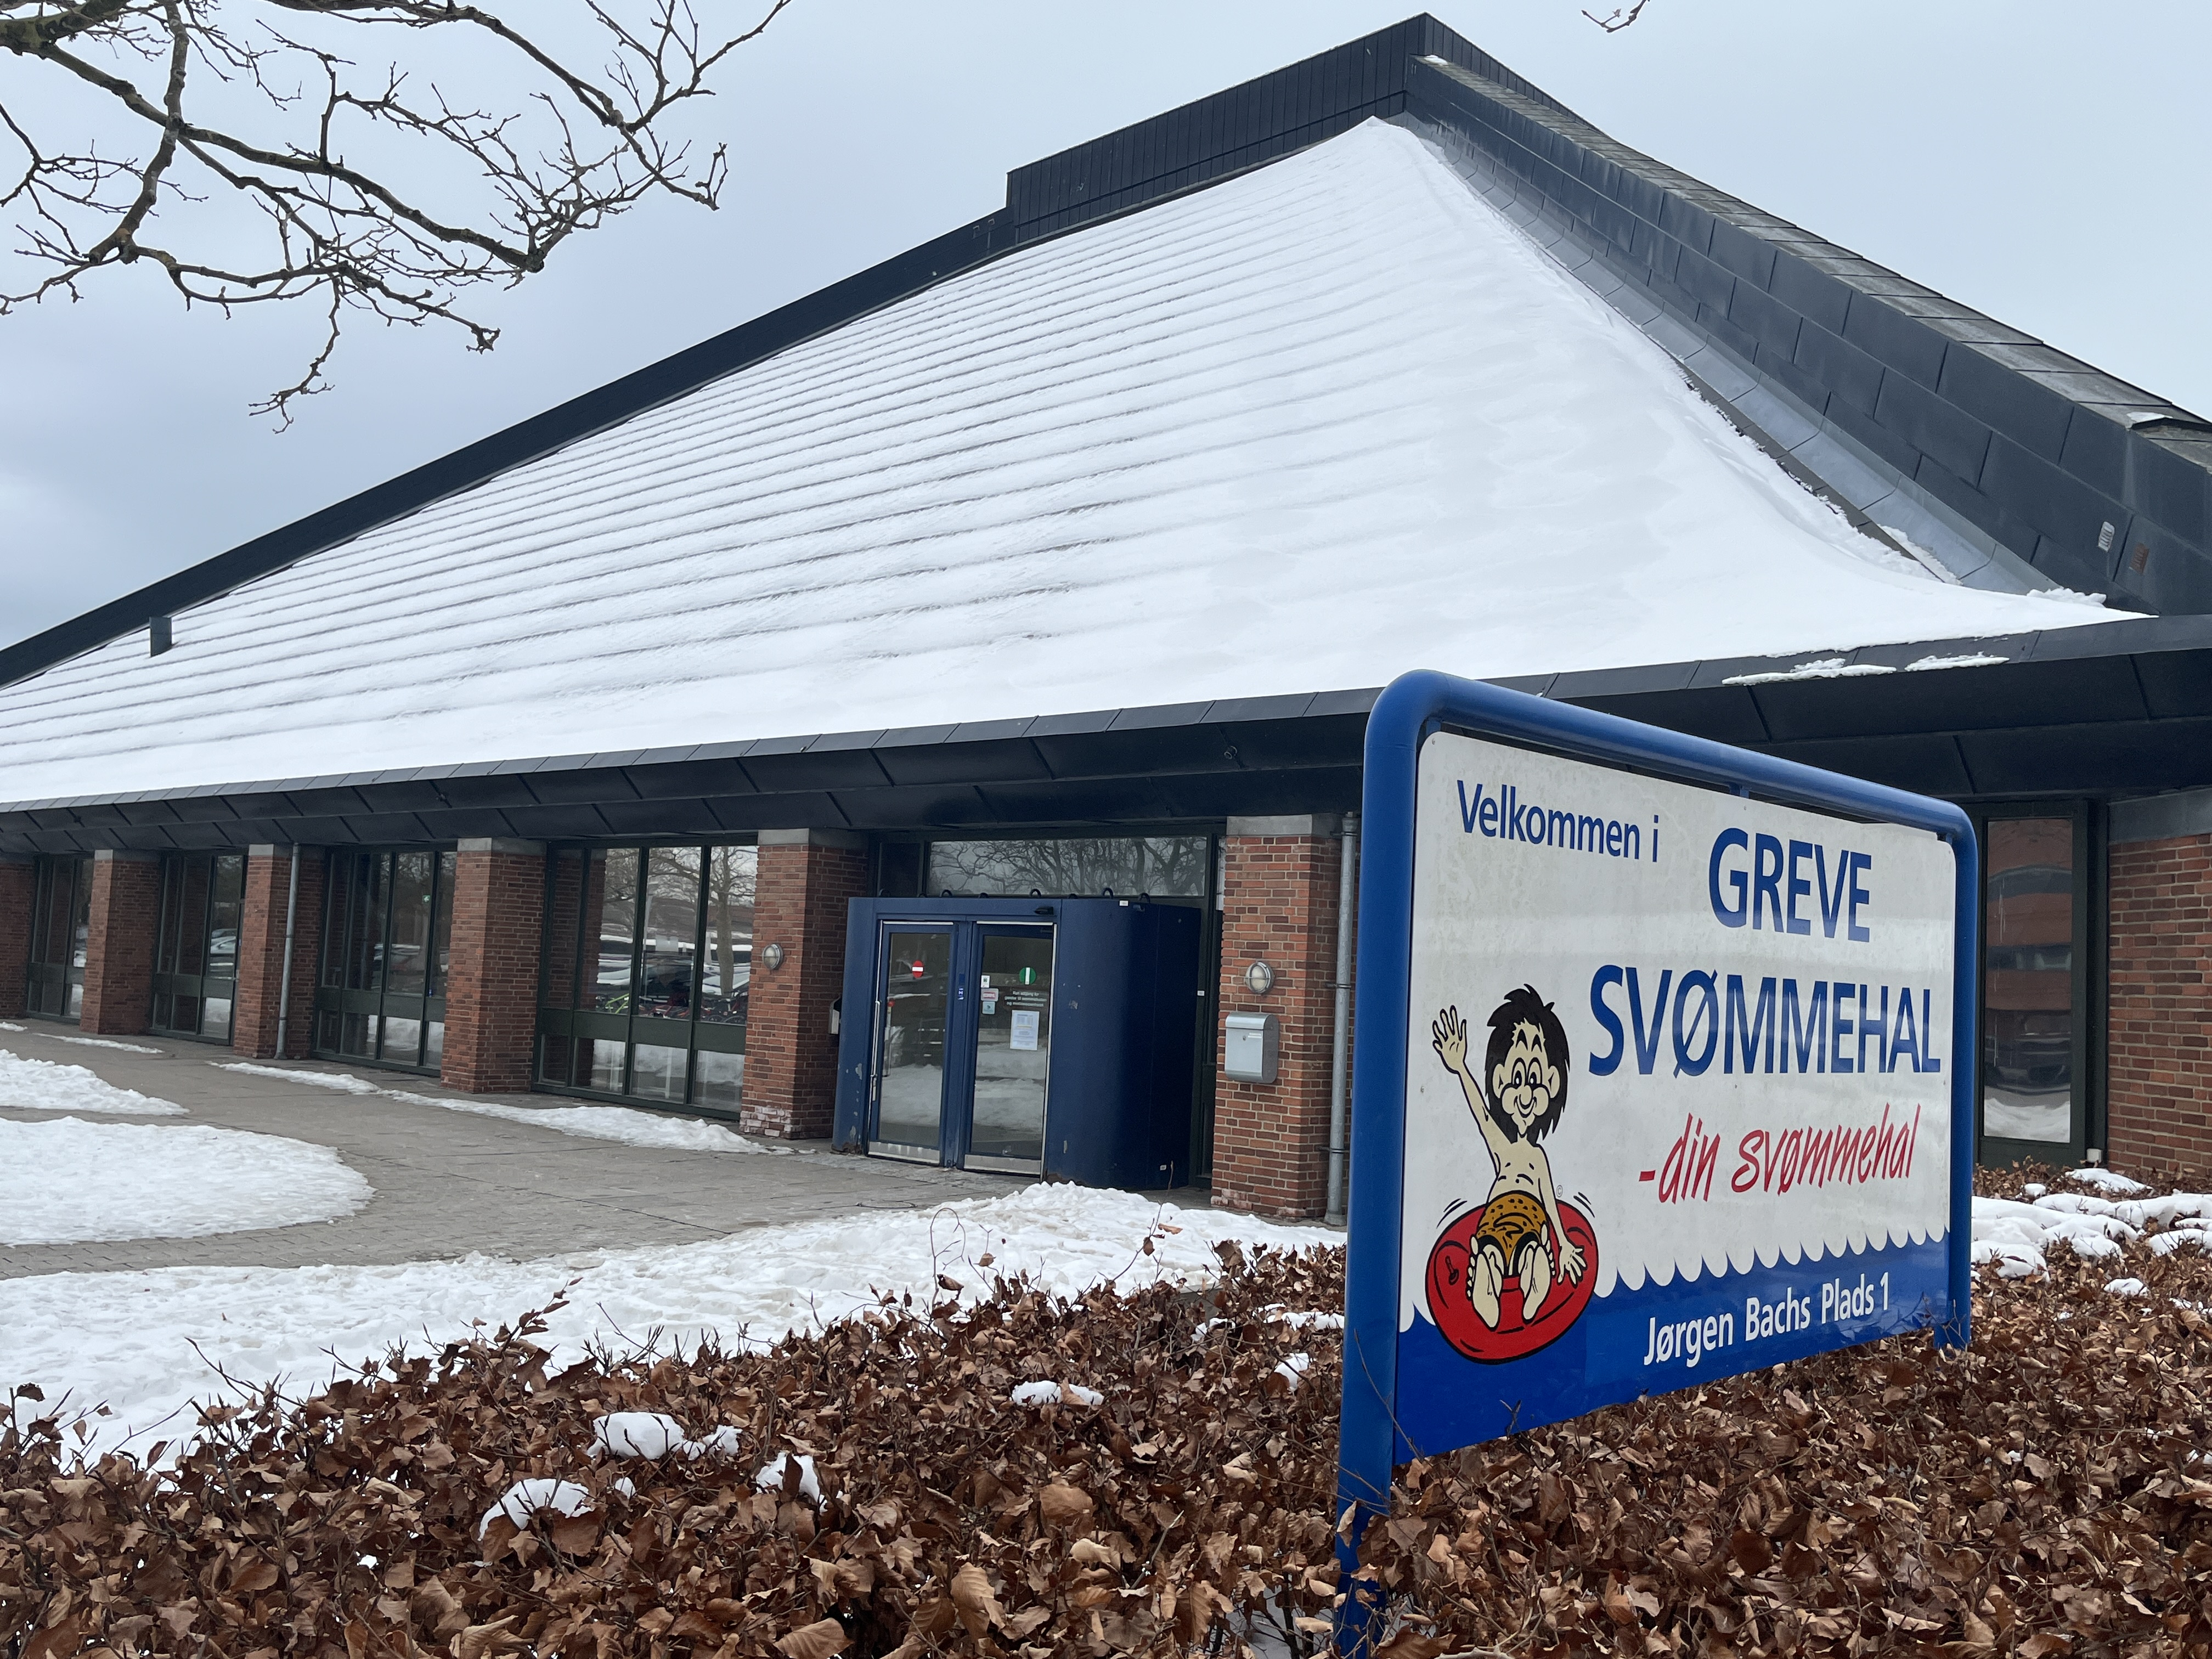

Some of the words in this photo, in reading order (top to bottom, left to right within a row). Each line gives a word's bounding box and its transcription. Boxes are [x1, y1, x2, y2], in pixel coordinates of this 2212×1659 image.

[1457, 780, 1640, 860] Velkommen
[1652, 815, 1659, 862] i
[1709, 827, 1872, 942] GREVE
[1588, 964, 1941, 1079] SVØMMEHAL
[1731, 1103, 1921, 1195] svømmehal
[1643, 1313, 1734, 1368] Jørgen
[1745, 1286, 1811, 1341] Bachs
[1821, 1273, 1875, 1325] Plads
[1880, 1272, 1889, 1310] 1
